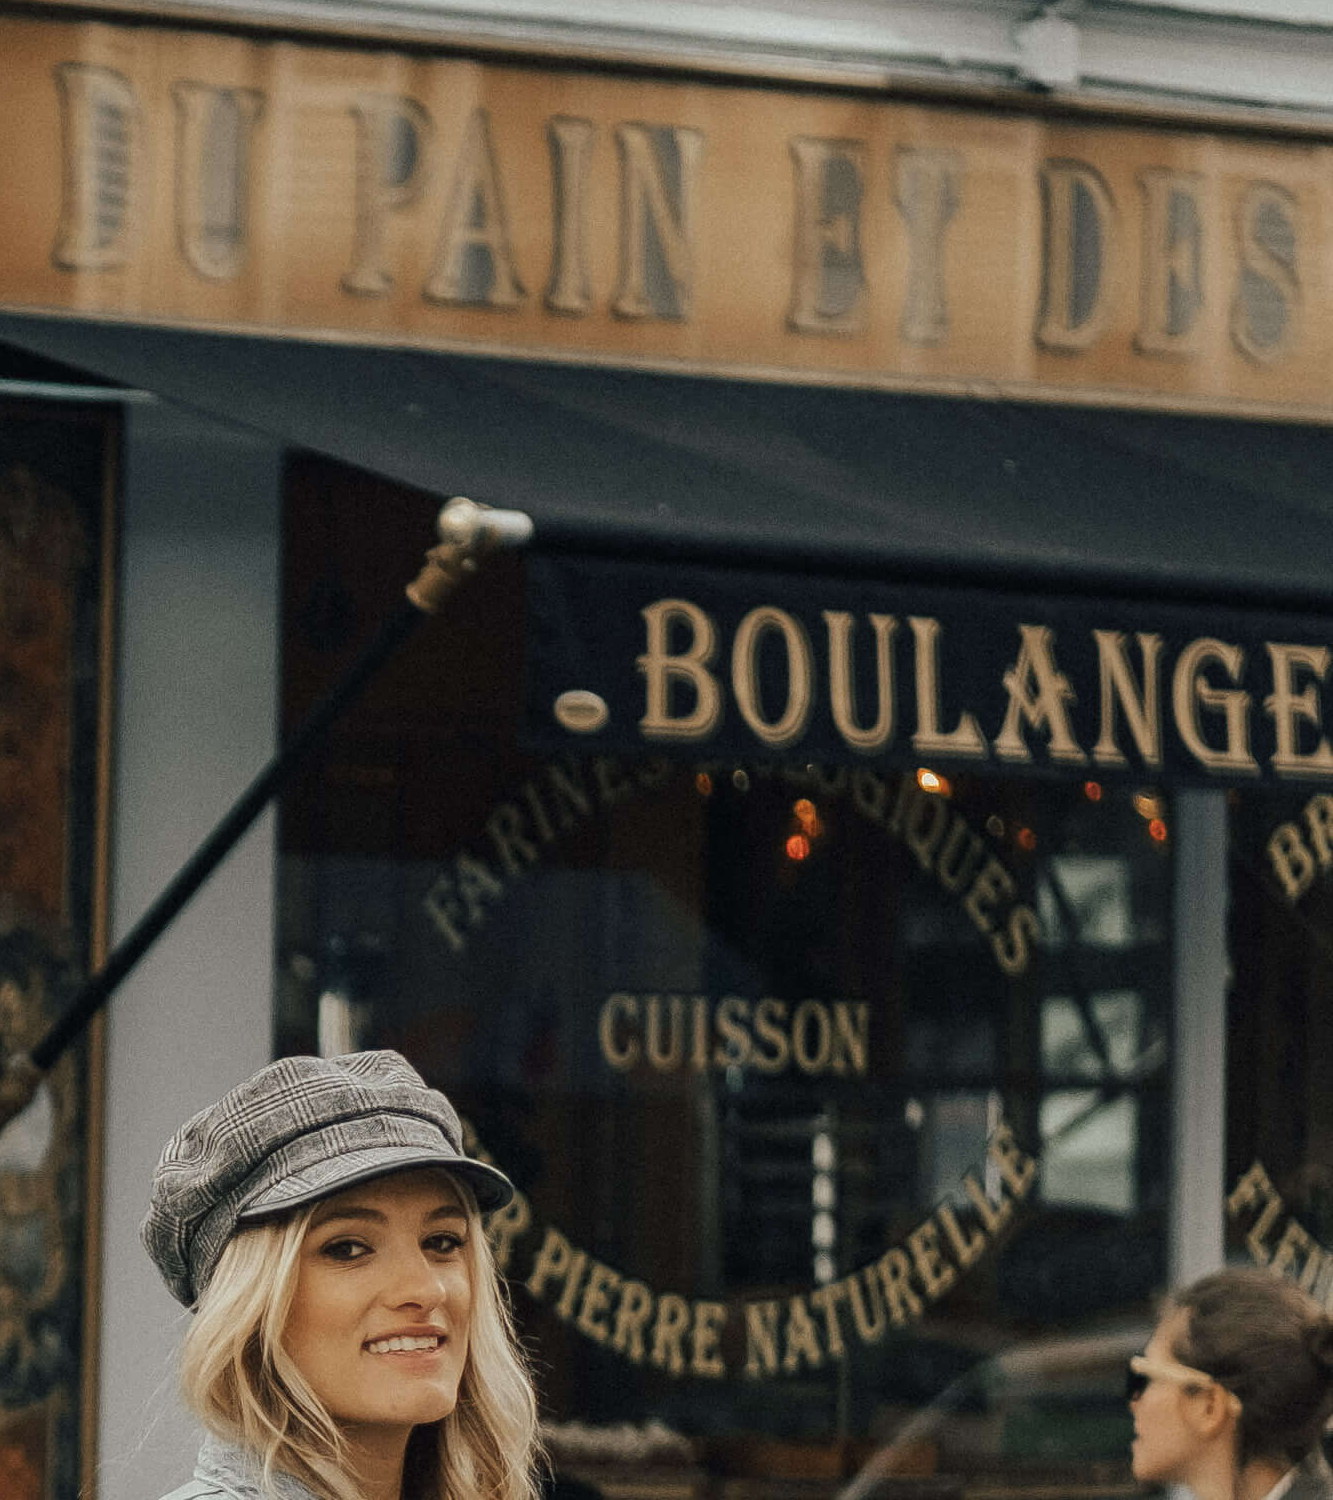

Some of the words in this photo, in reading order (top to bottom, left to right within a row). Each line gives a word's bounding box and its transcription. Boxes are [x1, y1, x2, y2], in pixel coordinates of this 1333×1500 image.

[49, 60, 267, 282] DU
[340, 96, 704, 326] PAIN
[1035, 155, 1307, 368] DES
[636, 595, 1333, 778] BOULANGE
[598, 992, 872, 1077] CUISSON
[526, 1227, 730, 1380] PIERRE
[742, 1121, 1037, 1381] NATURELLE
